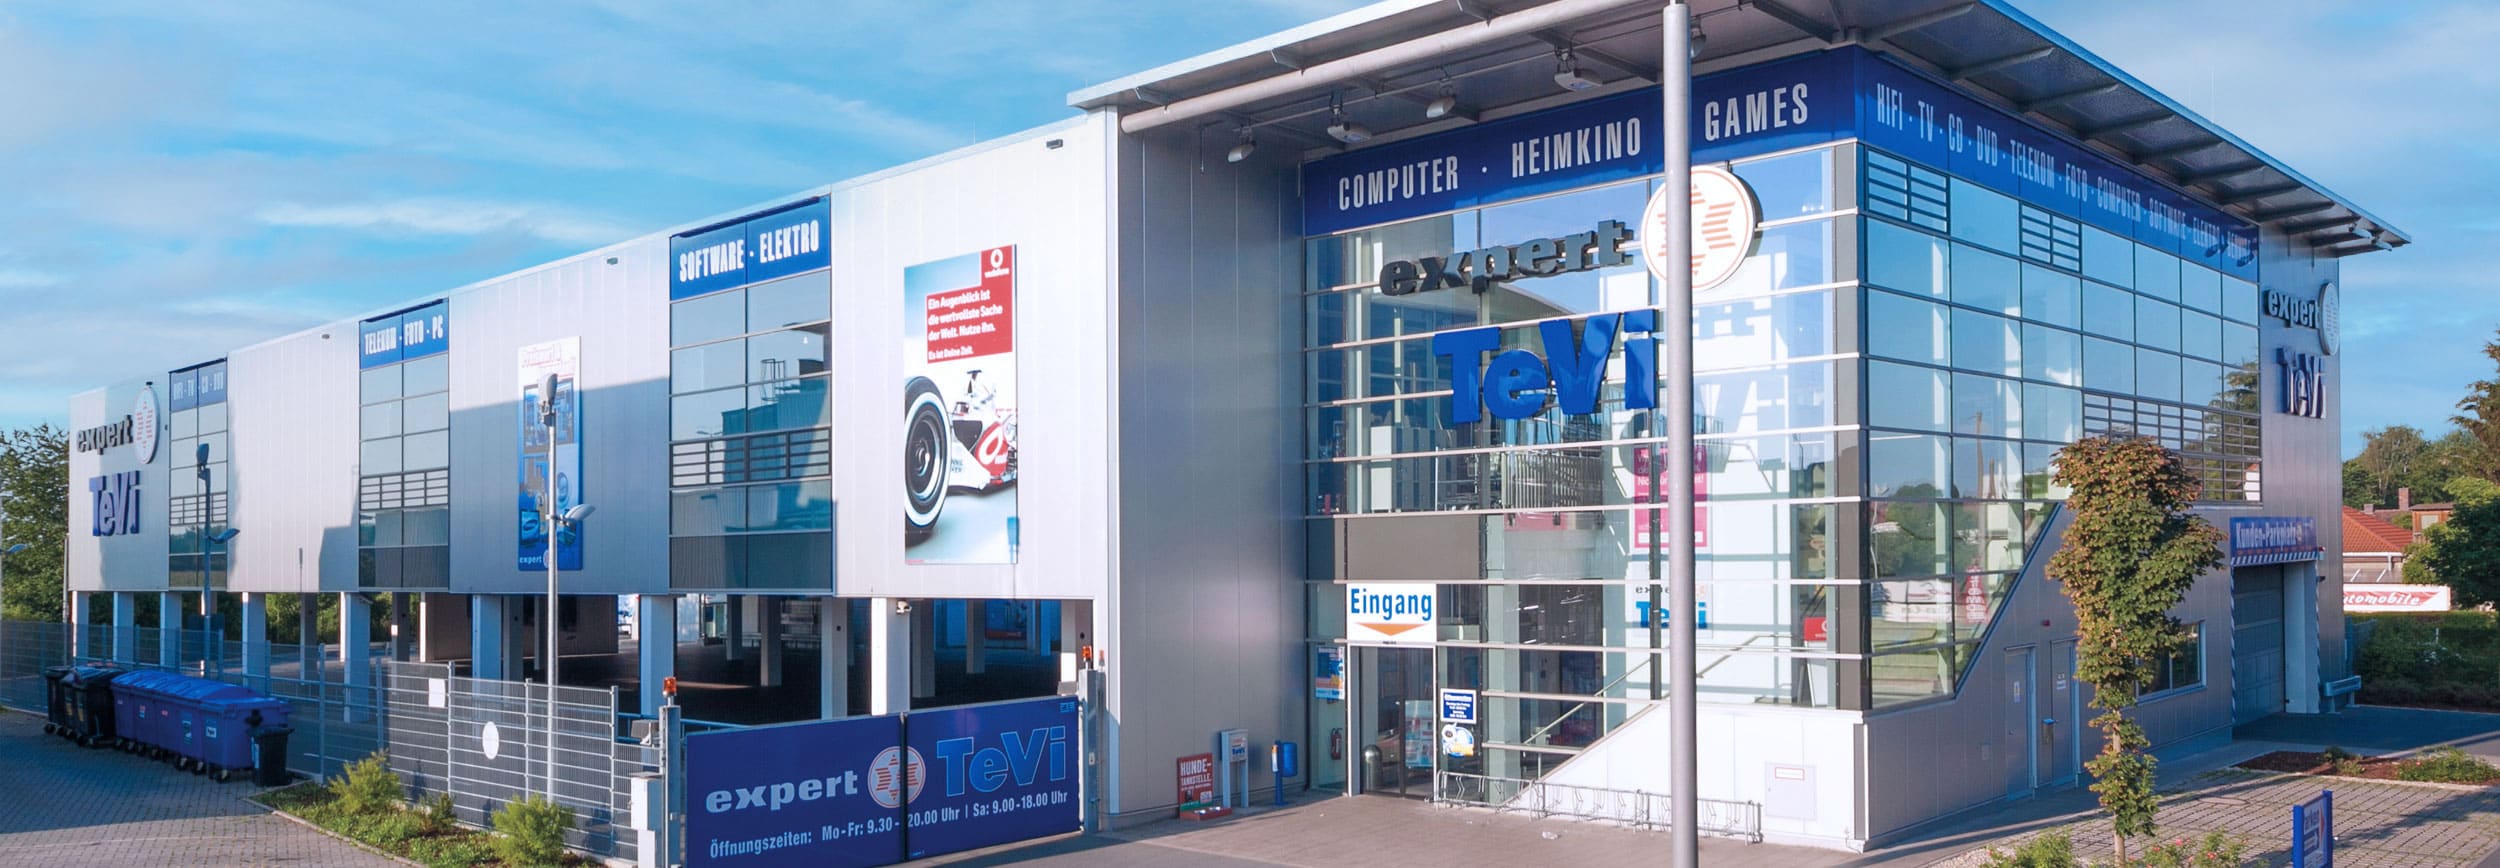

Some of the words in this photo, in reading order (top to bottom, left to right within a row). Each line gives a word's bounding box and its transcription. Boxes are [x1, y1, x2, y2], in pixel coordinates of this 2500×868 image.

[1339, 155, 1458, 211] COMPUTER
[1511, 117, 1641, 178] HEIMKINO
[1704, 83, 1808, 142] GAMES
[1877, 83, 1903, 131] HIFI
[1918, 101, 1934, 142] TV
[1948, 113, 1964, 153] CD
[1976, 125, 1998, 167] DVD
[2010, 139, 2055, 190] TELEKOM
[2065, 163, 2088, 202] FOTO
[2097, 176, 2141, 222] COMPUTER
[2148, 197, 2187, 241] SOFTWARE
[679, 239, 745, 283] SOFTWARE
[759, 219, 820, 264] ELEKTRO
[1379, 219, 1633, 296] expert
[928, 298, 940, 311] Ein
[941, 291, 980, 309] Augenblick
[980, 289, 991, 301] ist
[928, 314, 939, 326] die
[940, 308, 980, 324] wertvollste
[980, 304, 1004, 317] Sache
[2264, 288, 2320, 329] expert
[364, 326, 397, 356] TELEKOM
[404, 319, 424, 347] FOTO
[432, 314, 444, 340] PC
[928, 330, 941, 341] der
[940, 326, 958, 340] Welt.
[959, 325, 981, 336] Nutze
[1433, 308, 1658, 424] TeVi
[2276, 347, 2327, 420] TeVi
[76, 415, 134, 455] expert
[89, 469, 141, 538] TeVi
[2236, 521, 2297, 551] Kunden-Parkplatz
[519, 556, 542, 565] expert
[1350, 588, 1432, 621] Eingang
[1635, 601, 1707, 629] Tei
[2343, 589, 2421, 606] tomobile
[937, 726, 1066, 797] TeVi
[1181, 758, 1212, 777] HUNDE-
[706, 770, 859, 814] expert
[710, 830, 812, 859] Öffnungszeiten:
[907, 809, 938, 828] 20.00
[941, 807, 961, 823] Uhr
[972, 799, 990, 818] Sa:
[1051, 791, 1068, 805] Uhr
